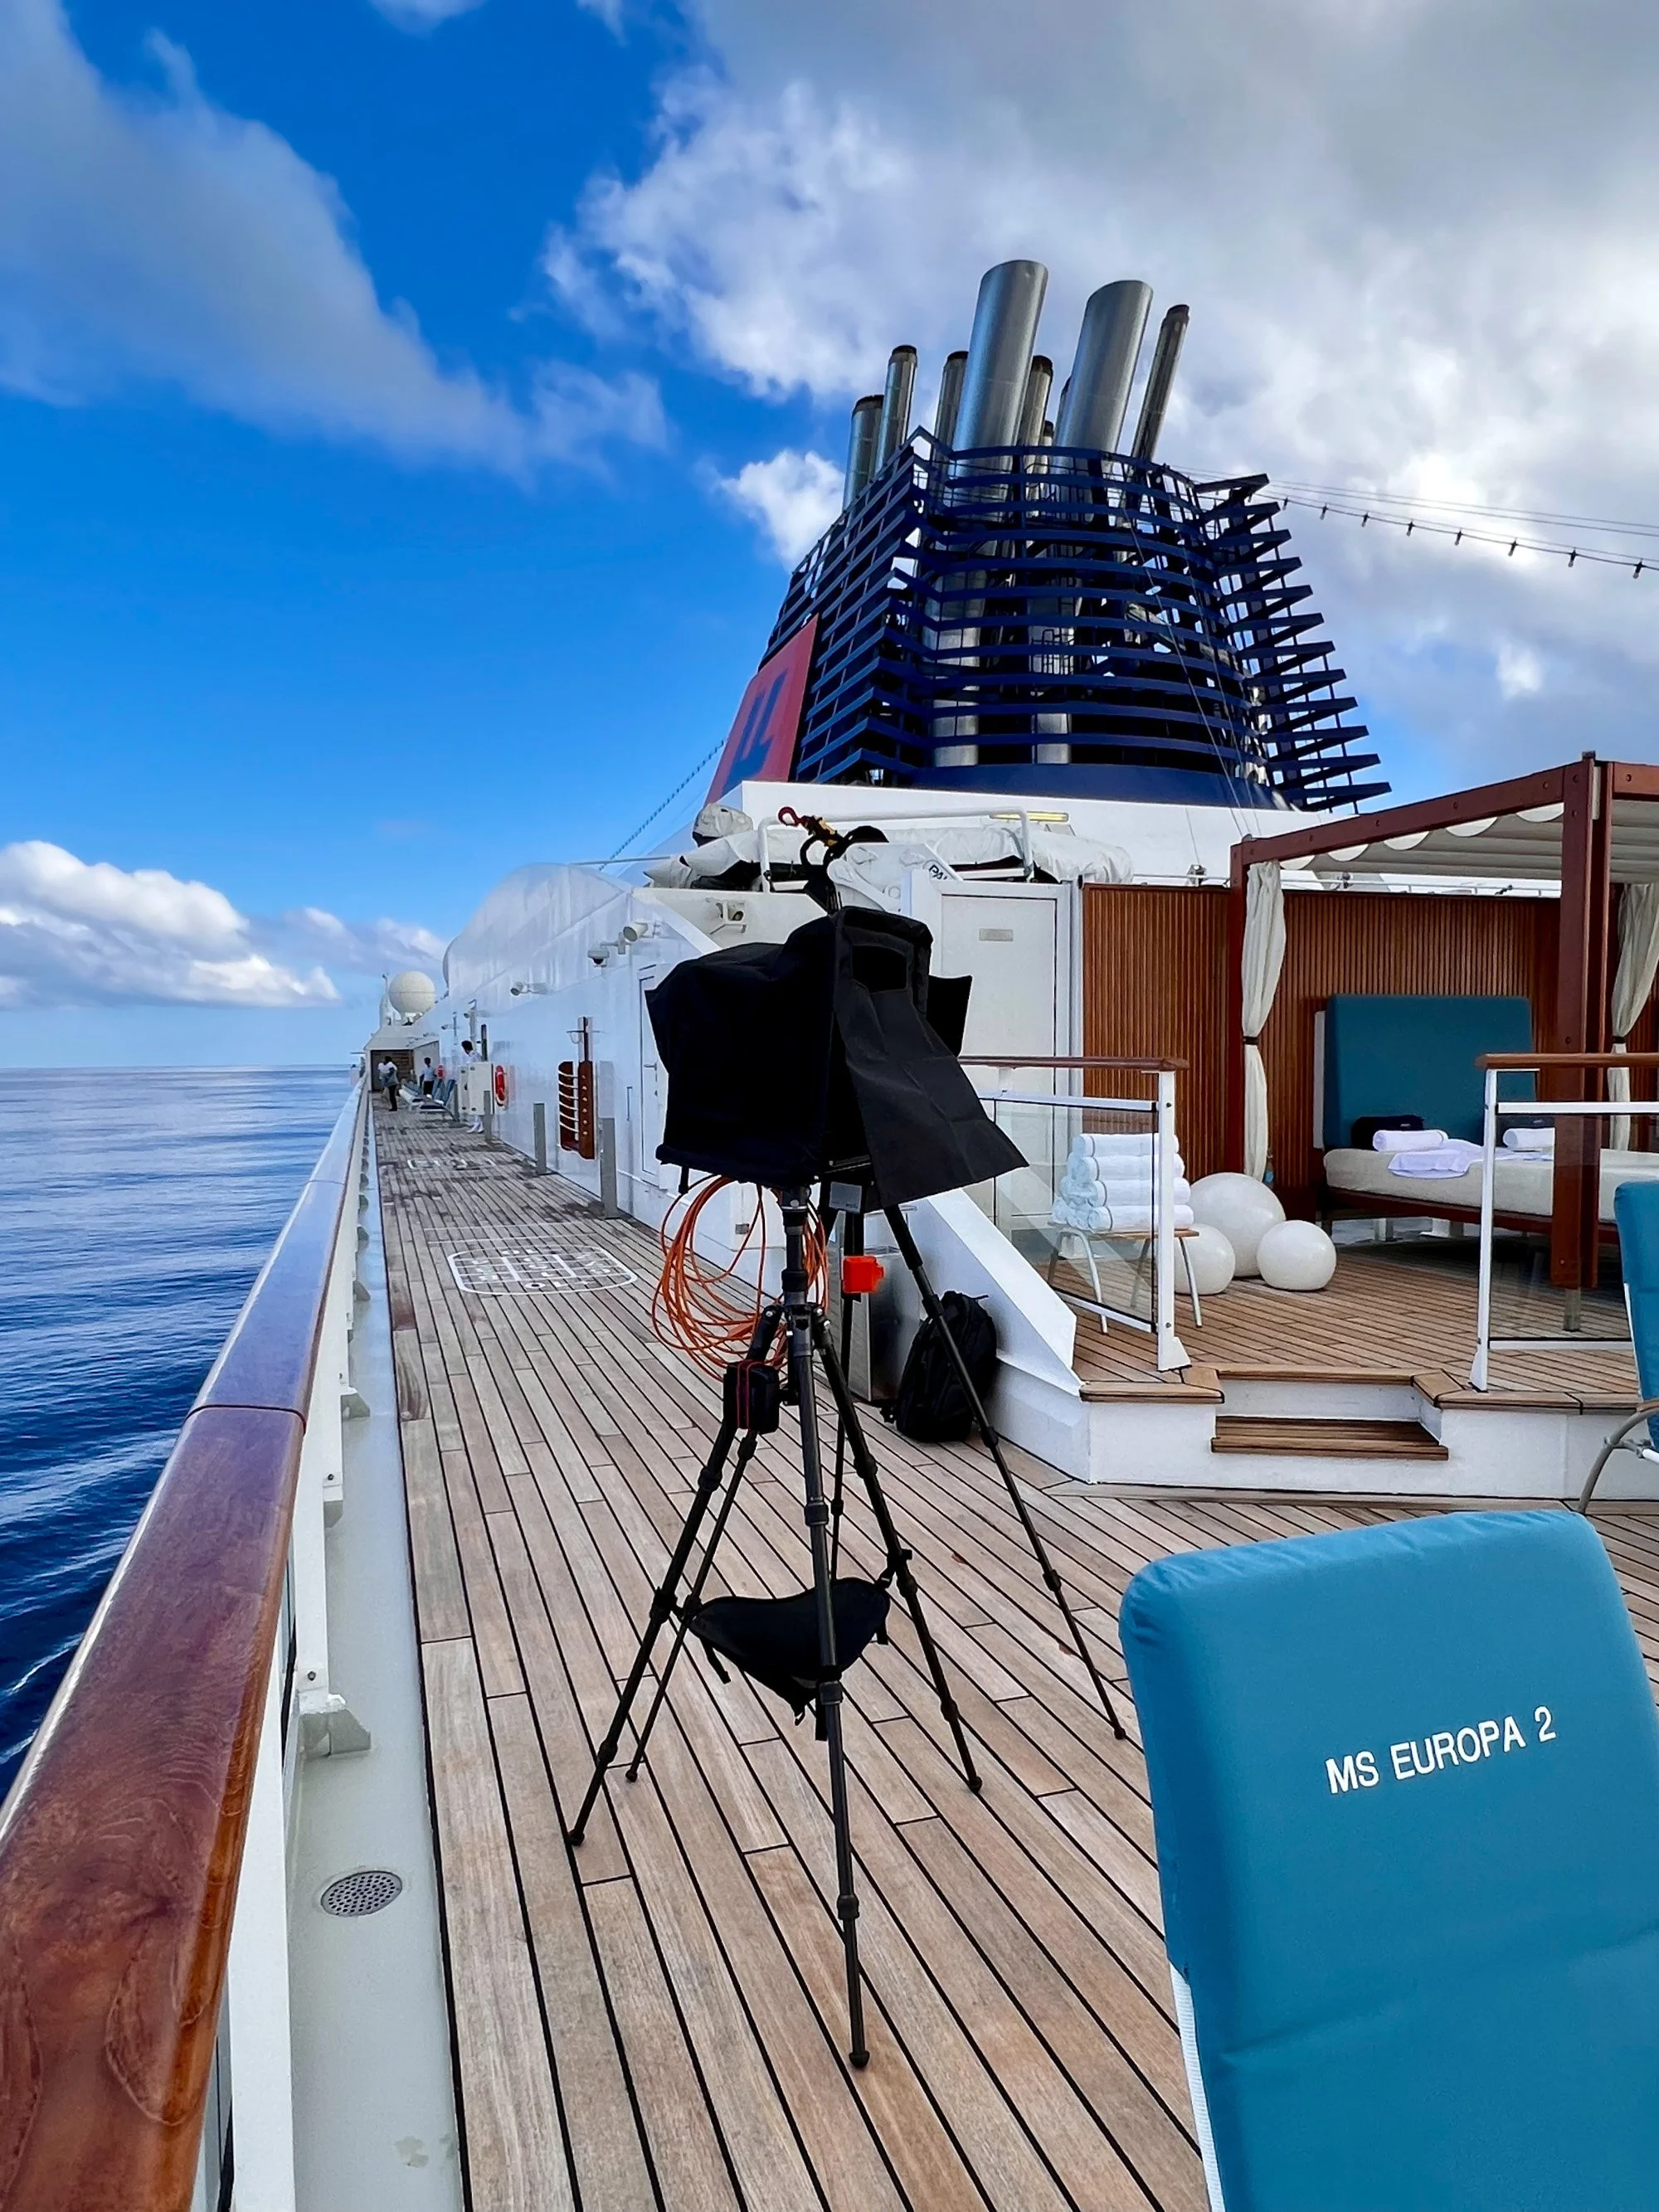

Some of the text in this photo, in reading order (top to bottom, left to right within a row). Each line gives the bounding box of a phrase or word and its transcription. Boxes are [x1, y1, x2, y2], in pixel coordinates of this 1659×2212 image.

[928, 863, 948, 880] PA
[1325, 1704, 1557, 1794] MS EUROPA 2
